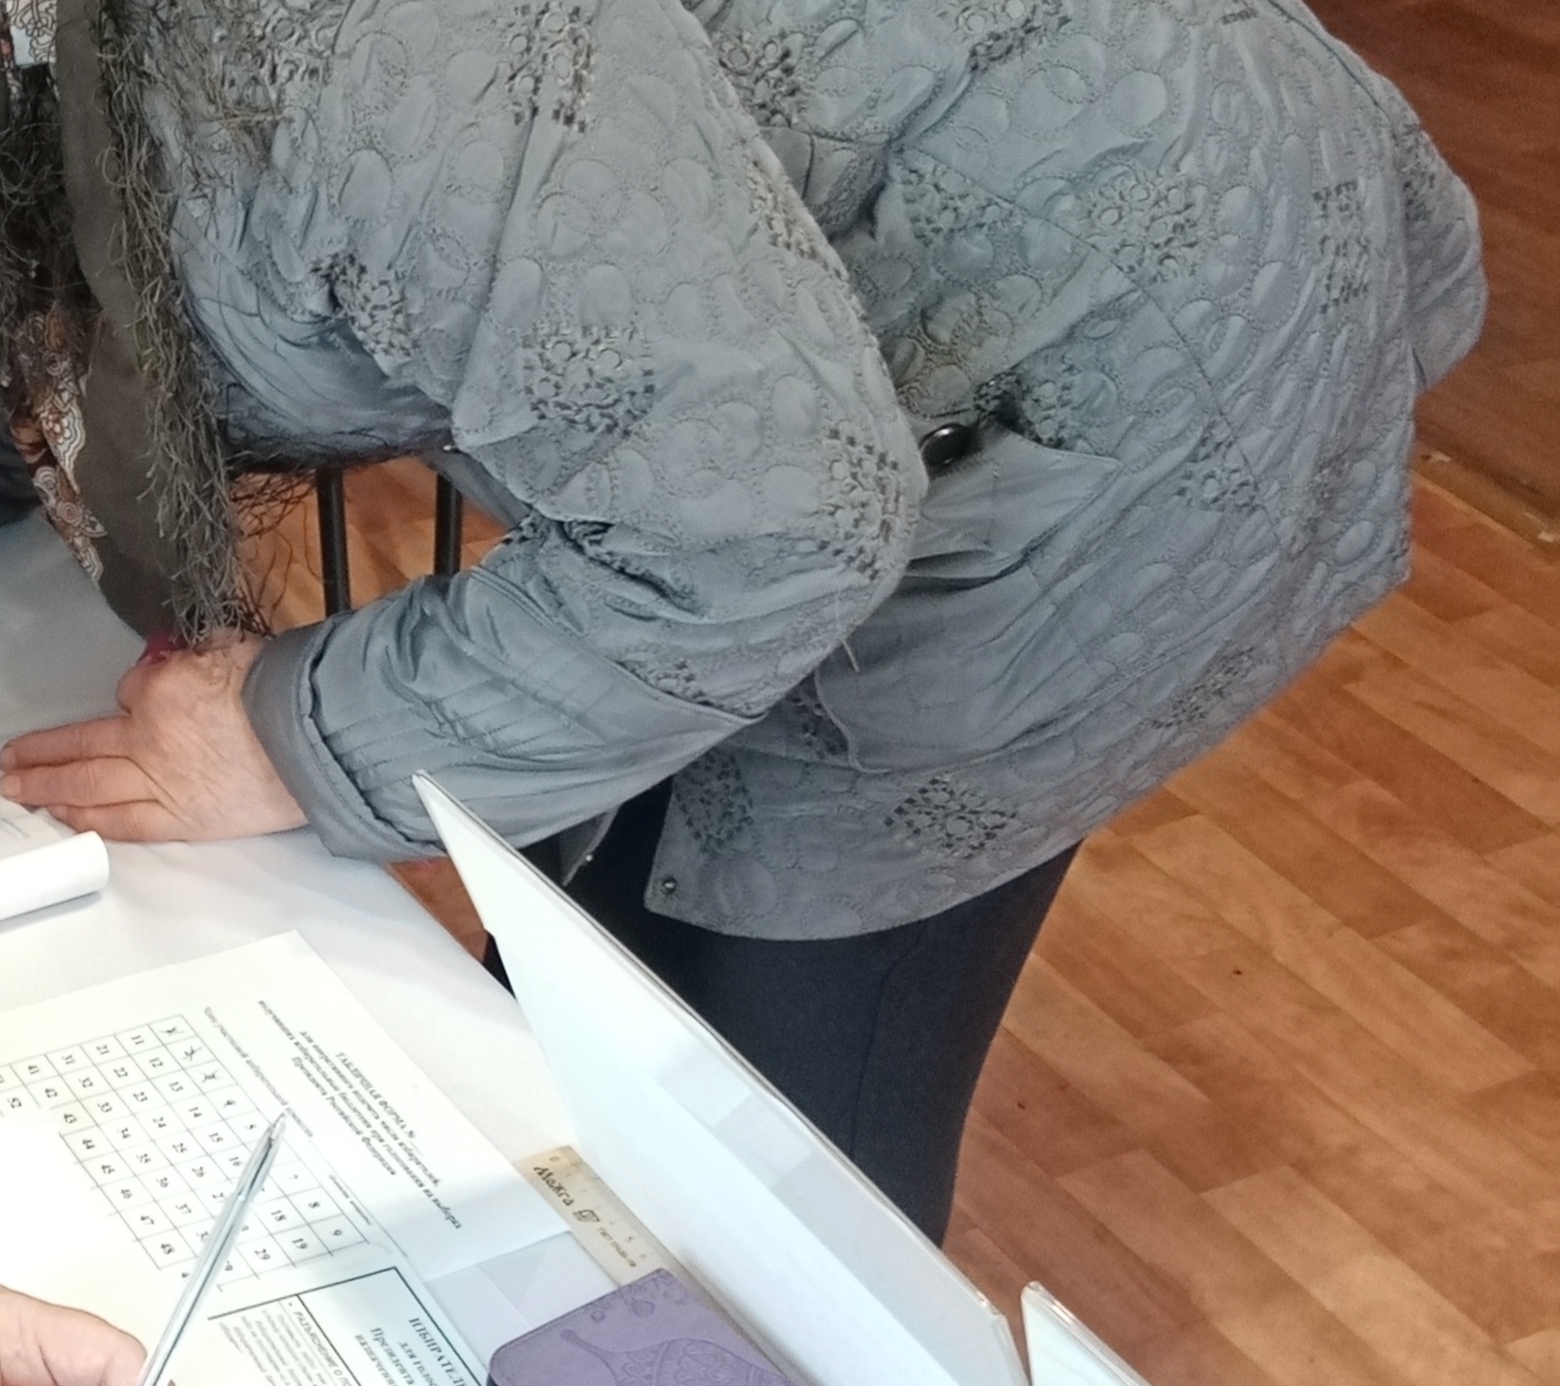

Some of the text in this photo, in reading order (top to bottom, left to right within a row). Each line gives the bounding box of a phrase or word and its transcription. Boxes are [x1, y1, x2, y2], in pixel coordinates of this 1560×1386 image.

[7, 1097, 23, 1110] 52
[27, 1064, 41, 1076] 41
[44, 1086, 59, 1100] 42
[63, 1112, 78, 1125] 43
[81, 1137, 96, 1151] 44
[101, 1163, 116, 1176] 45
[120, 1187, 133, 1200] 46
[140, 1213, 156, 1227] 47
[160, 1242, 175, 1256] 48
[61, 1053, 76, 1066] 31
[79, 1076, 94, 1089] 32
[97, 1101, 113, 1114] 33
[116, 1127, 131, 1140] 34
[136, 1152, 152, 1165] 35
[155, 1176, 169, 1189] 36
[175, 1202, 193, 1215] 37
[96, 1044, 271, 1262] 21 22 23 24 25 26 2 29
[131, 1034, 145, 1046] 11
[149, 1056, 164, 1069] 12
[169, 1081, 184, 1094] 13
[189, 1106, 203, 1119] 14
[208, 1132, 224, 1145] 15
[270, 1209, 286, 1223] 18
[291, 1237, 309, 1251] 19
[308, 1201, 320, 1210] 8
[331, 1228, 343, 1238] 9
[369, 1326, 415, 1386] Президента
